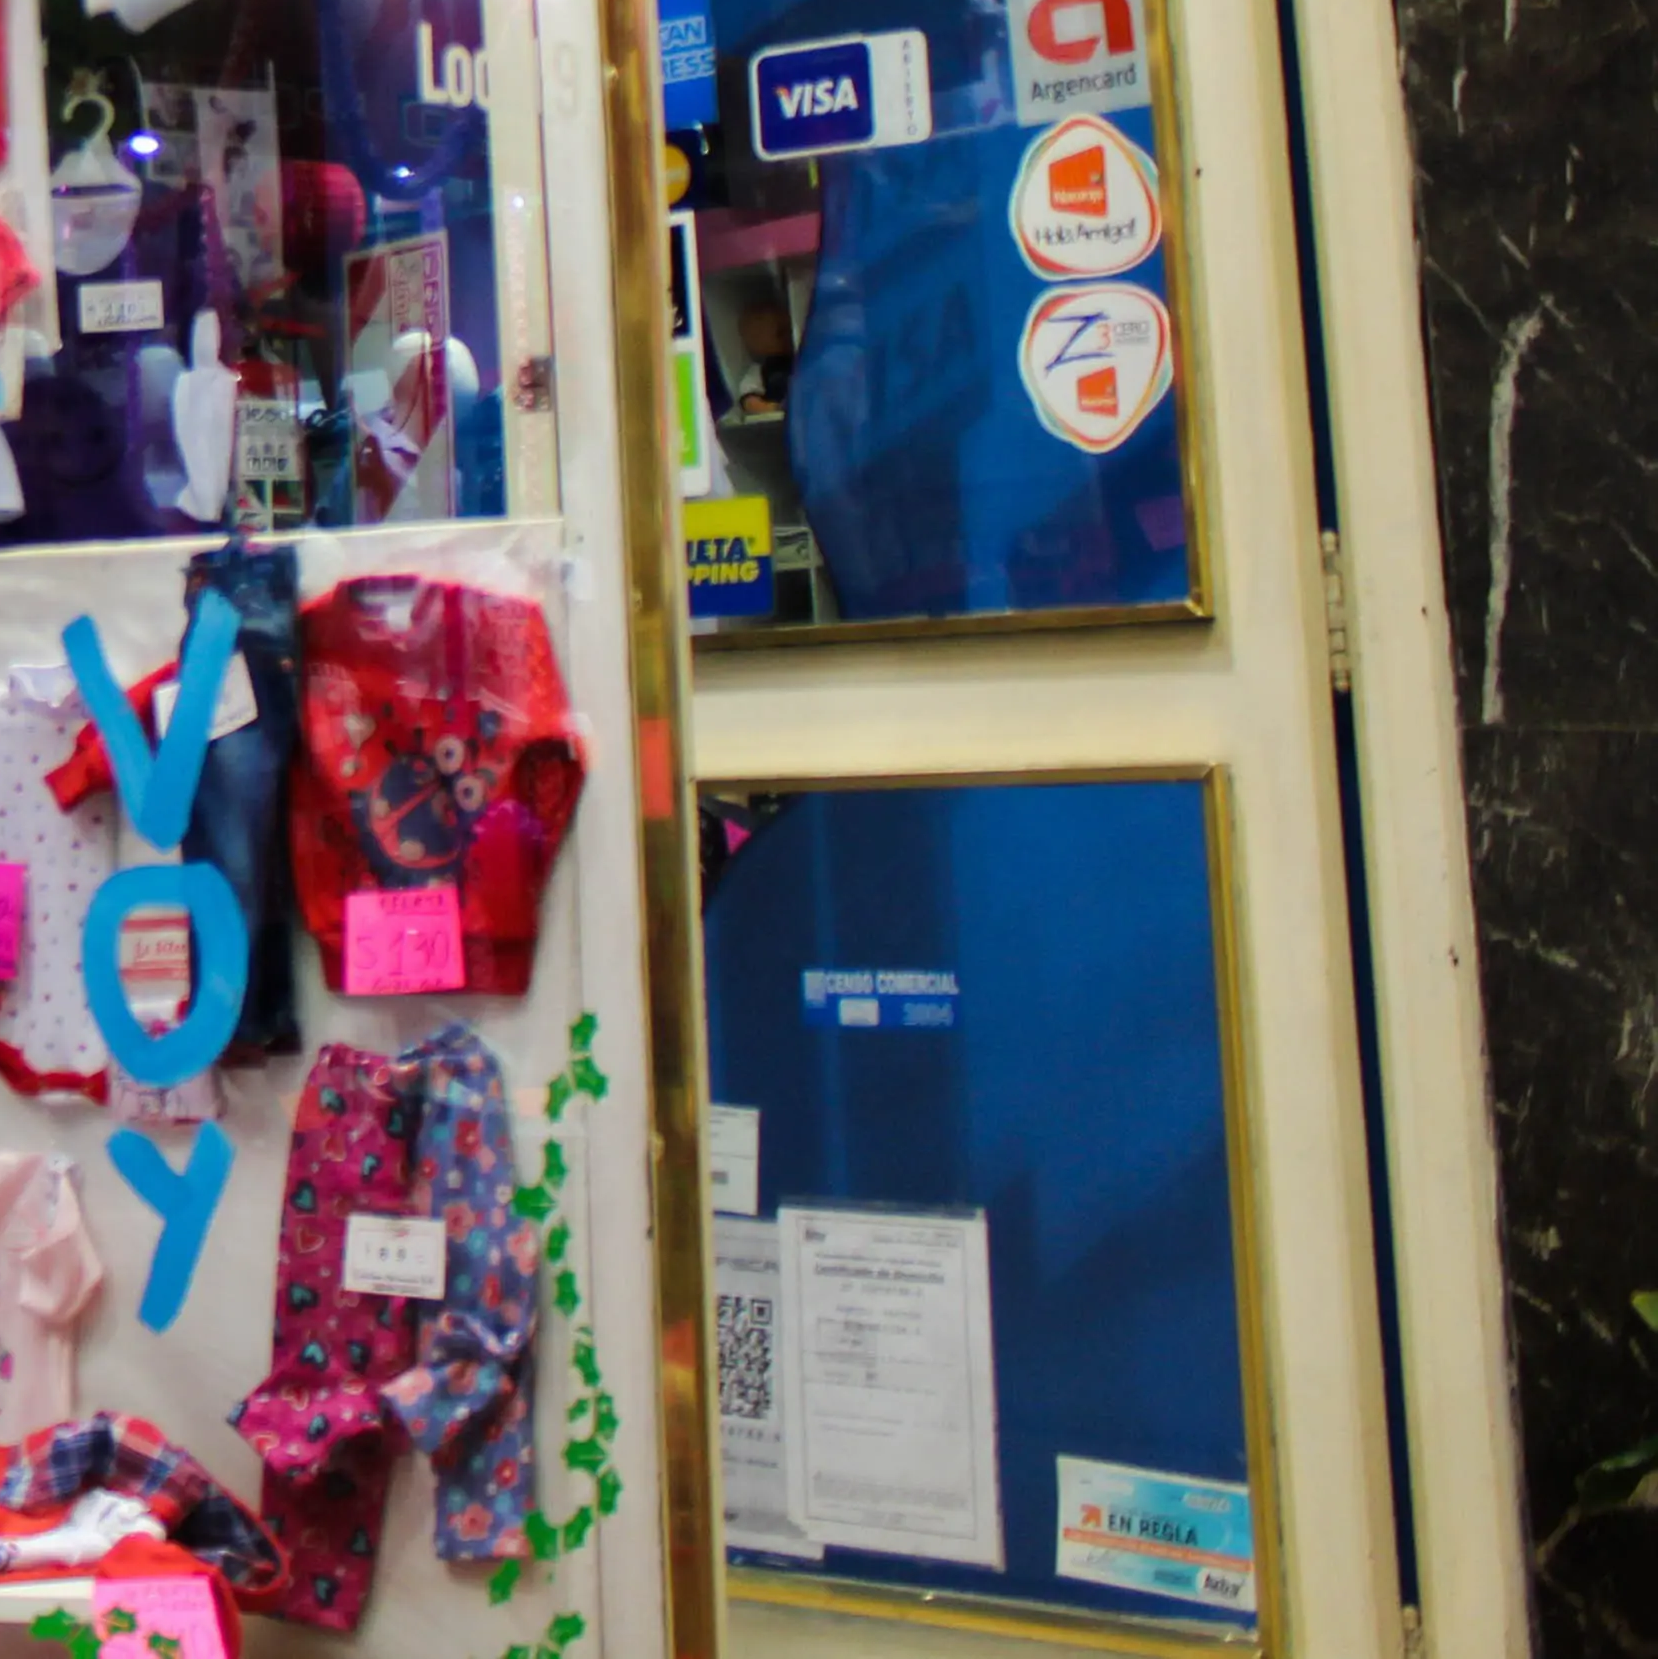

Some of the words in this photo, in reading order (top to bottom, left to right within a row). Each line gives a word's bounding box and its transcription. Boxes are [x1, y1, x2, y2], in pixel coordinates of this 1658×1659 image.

[775, 76, 860, 120] VISA
[1032, 63, 1139, 106] Argencard
[60, 587, 250, 1334] VOY
[1108, 1511, 1133, 1534] EN
[1138, 1517, 1200, 1548] REGLA
